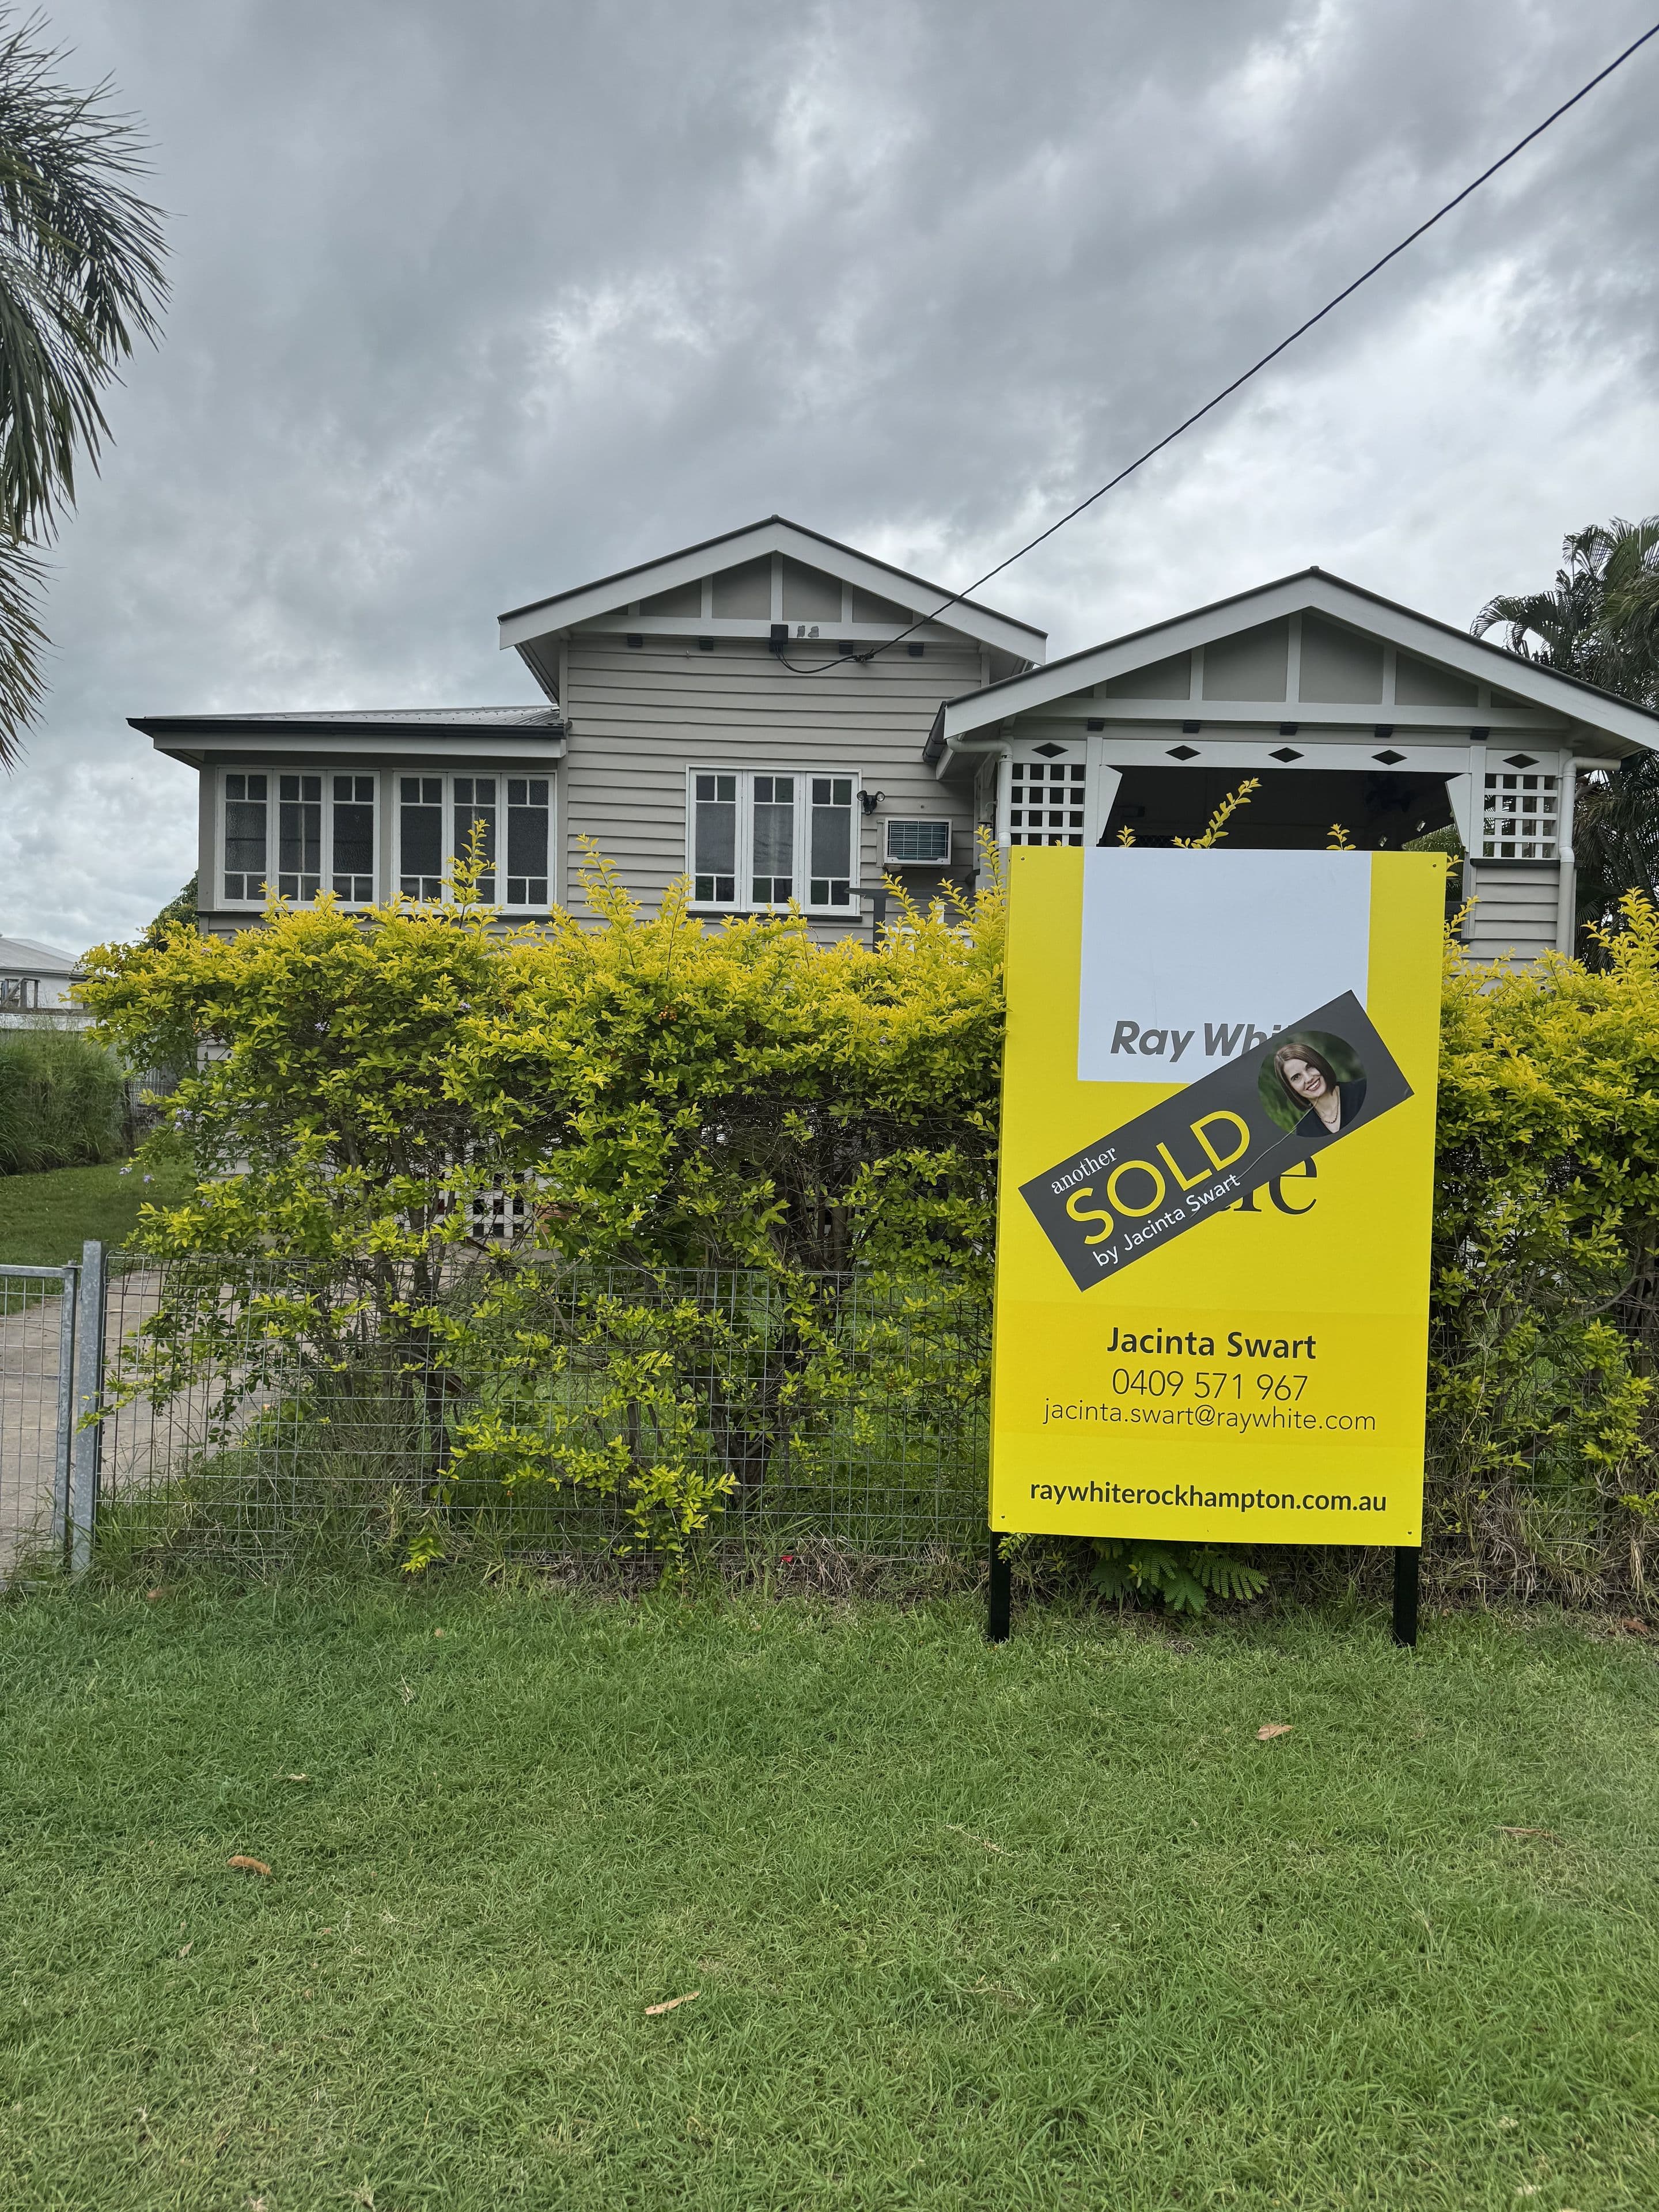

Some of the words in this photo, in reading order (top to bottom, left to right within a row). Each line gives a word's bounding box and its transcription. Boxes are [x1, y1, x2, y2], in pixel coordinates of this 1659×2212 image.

[1110, 1020, 1195, 1063] Ray
[1204, 1022, 1289, 1057] Wh
[1051, 1147, 1117, 1194] another
[1066, 1111, 1250, 1244] SOLD
[1092, 1245, 1118, 1267] by
[1123, 1208, 1186, 1251] Jacinta
[1185, 1173, 1241, 1212] Swart
[1107, 1327, 1214, 1357] Jacinta
[1227, 1331, 1316, 1359] Swart
[1112, 1368, 1184, 1397] 0409
[1194, 1372, 1242, 1400] 571
[1256, 1374, 1308, 1402] 967
[1043, 1398, 1376, 1433] jacinta.swart@raywhite.com
[1031, 1480, 1387, 1513] raywhiterockhampton.com.au
